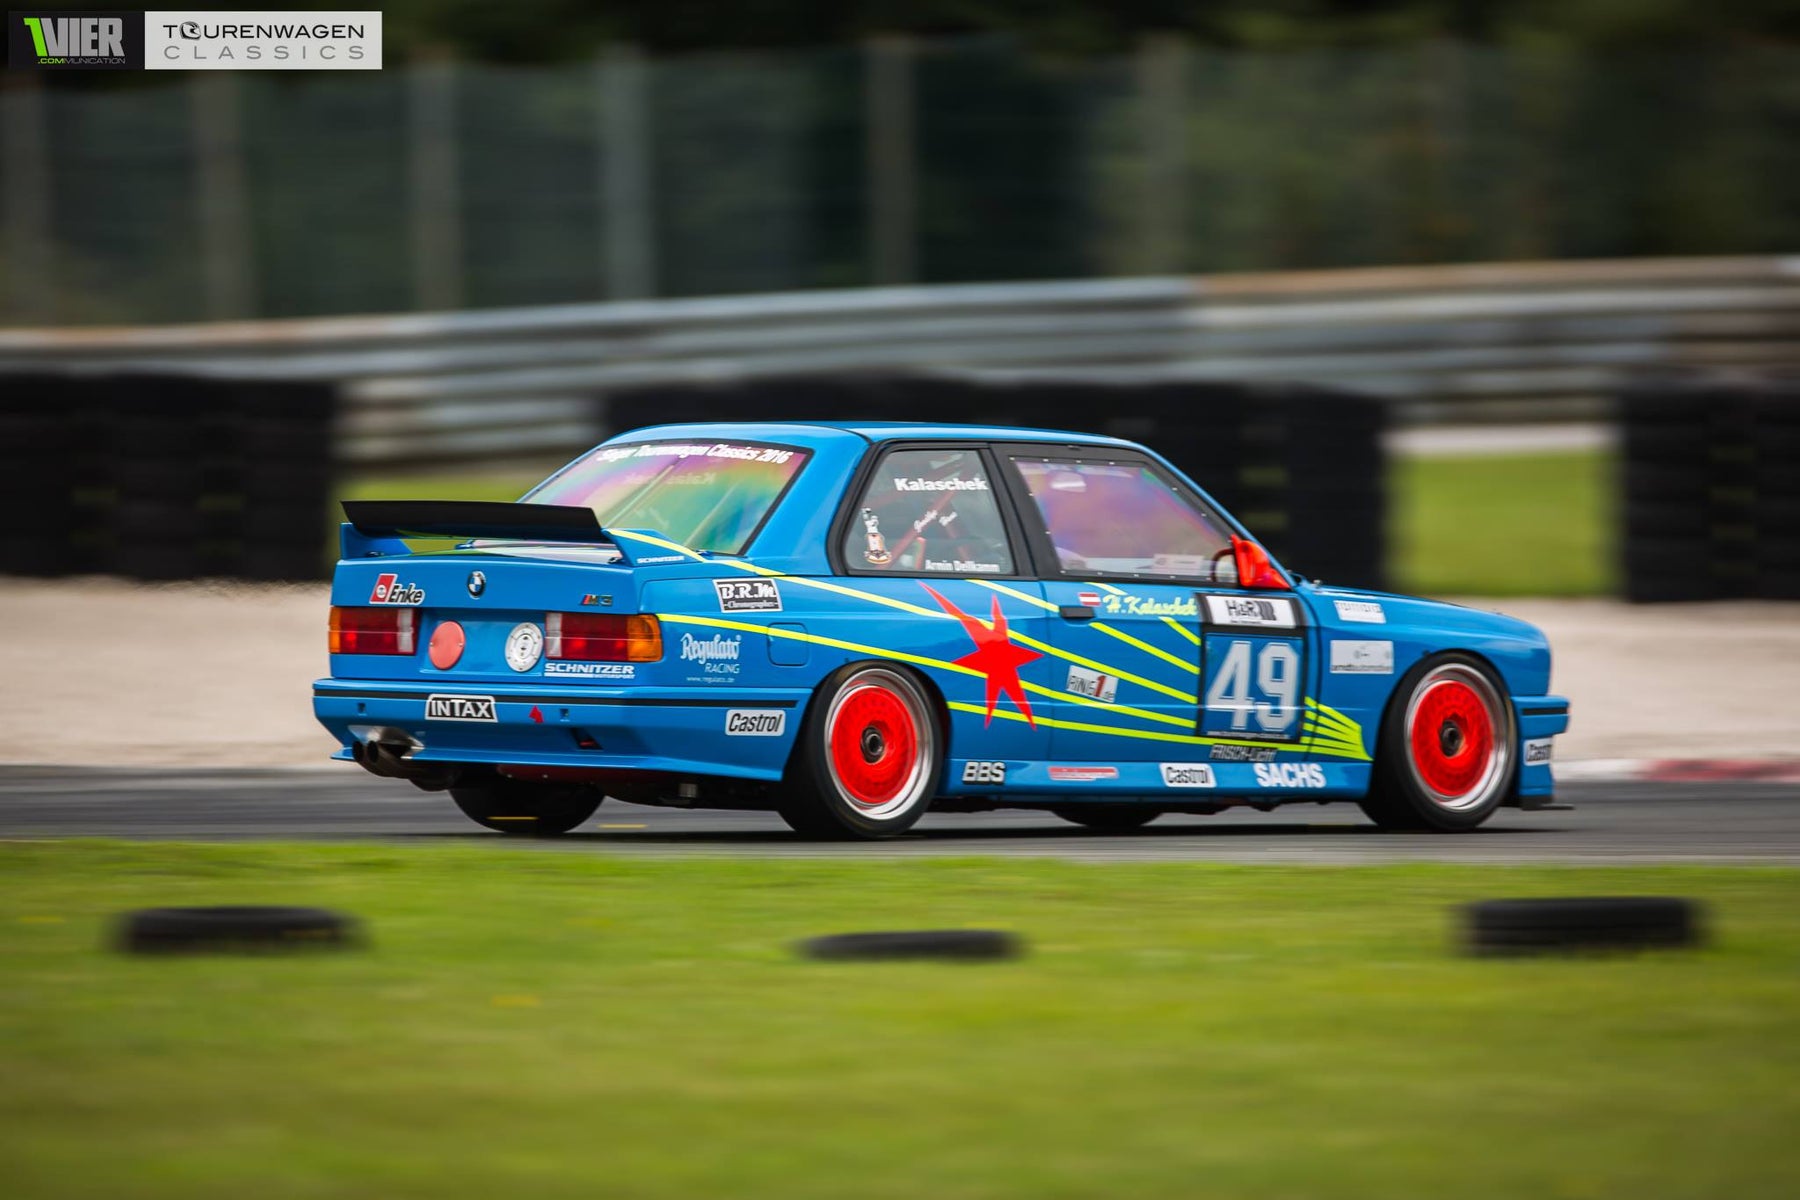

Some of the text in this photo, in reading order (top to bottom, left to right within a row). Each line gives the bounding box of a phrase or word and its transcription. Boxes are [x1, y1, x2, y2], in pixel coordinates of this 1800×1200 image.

[707, 444, 760, 460] Classics
[756, 449, 793, 464] 2016
[894, 478, 988, 491] Kalaschek
[388, 584, 423, 603] Enke
[582, 595, 613, 605] M3
[545, 663, 634, 674] SCHNITZER
[705, 663, 740, 674] RACING
[1206, 641, 1299, 731] 49
[431, 699, 491, 718] INTAX
[729, 713, 783, 732] Castrol
[963, 761, 1006, 784] BBS
[1166, 766, 1209, 784] Castrol
[1253, 763, 1327, 788] SACHS
